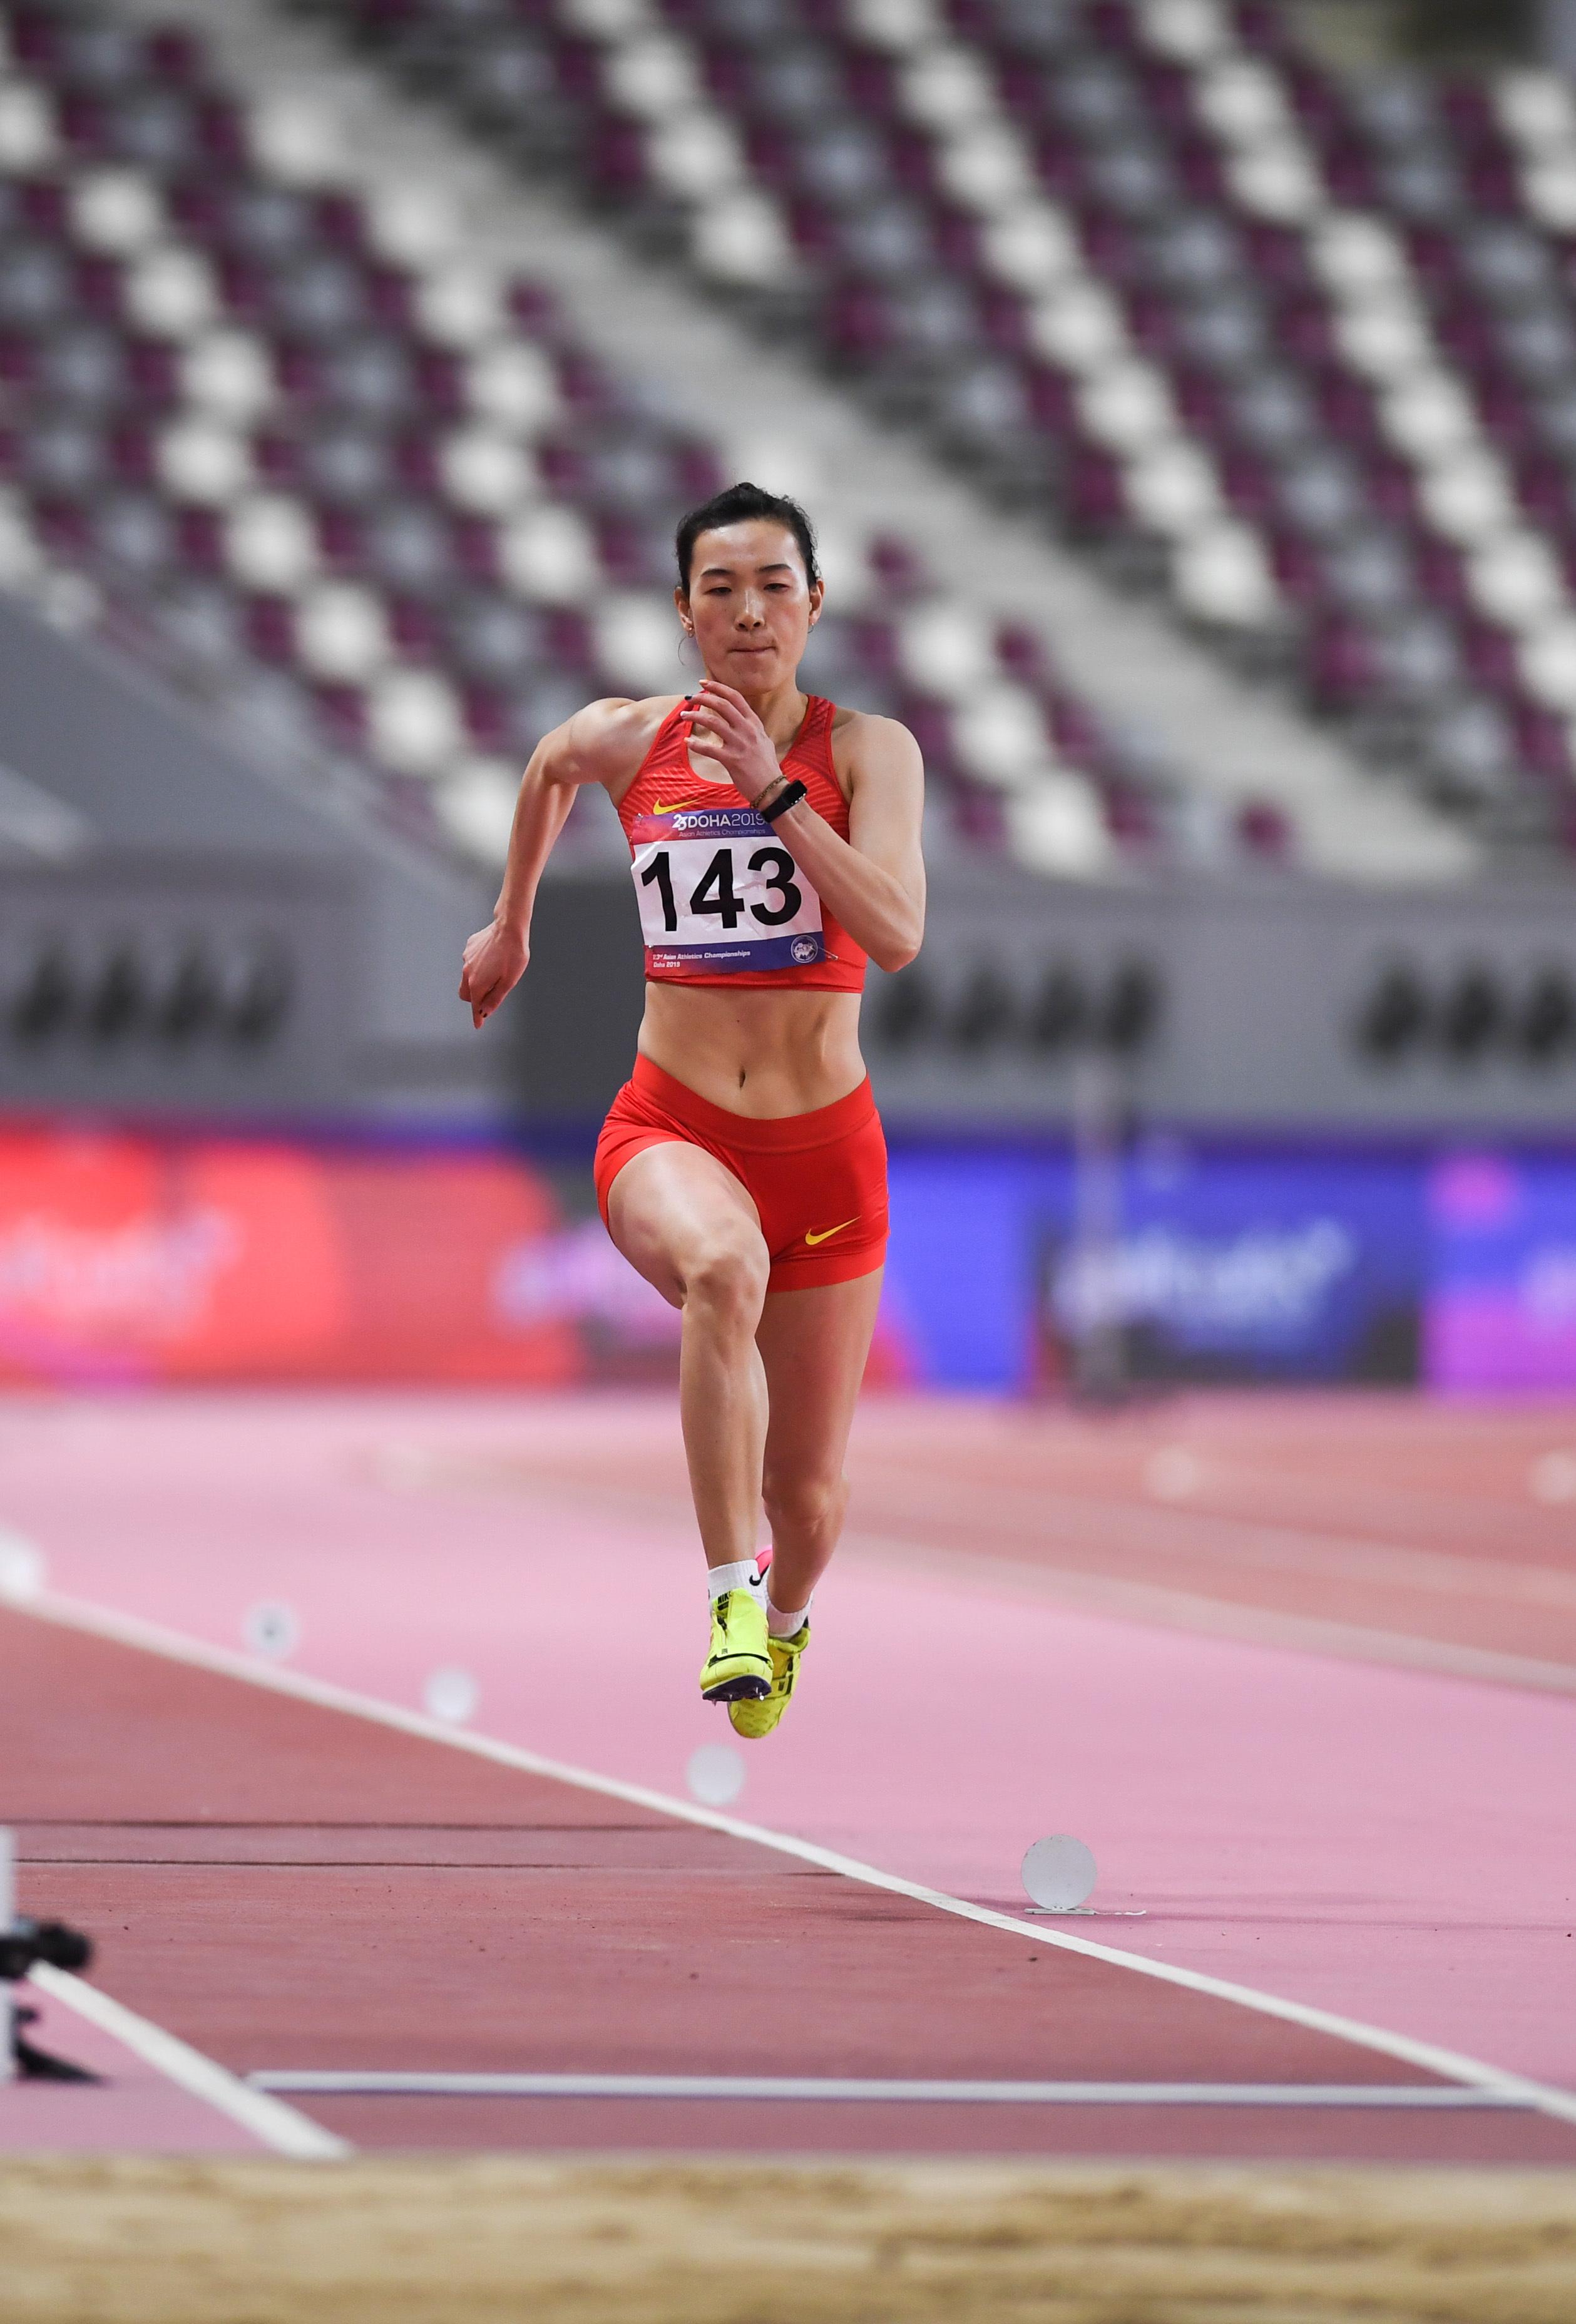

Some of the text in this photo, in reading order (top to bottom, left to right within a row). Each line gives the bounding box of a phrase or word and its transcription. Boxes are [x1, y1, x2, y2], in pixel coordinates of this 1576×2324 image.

[696, 829, 720, 837] Athletics
[640, 846, 802, 932] 143
[704, 950, 750, 959] Championships
